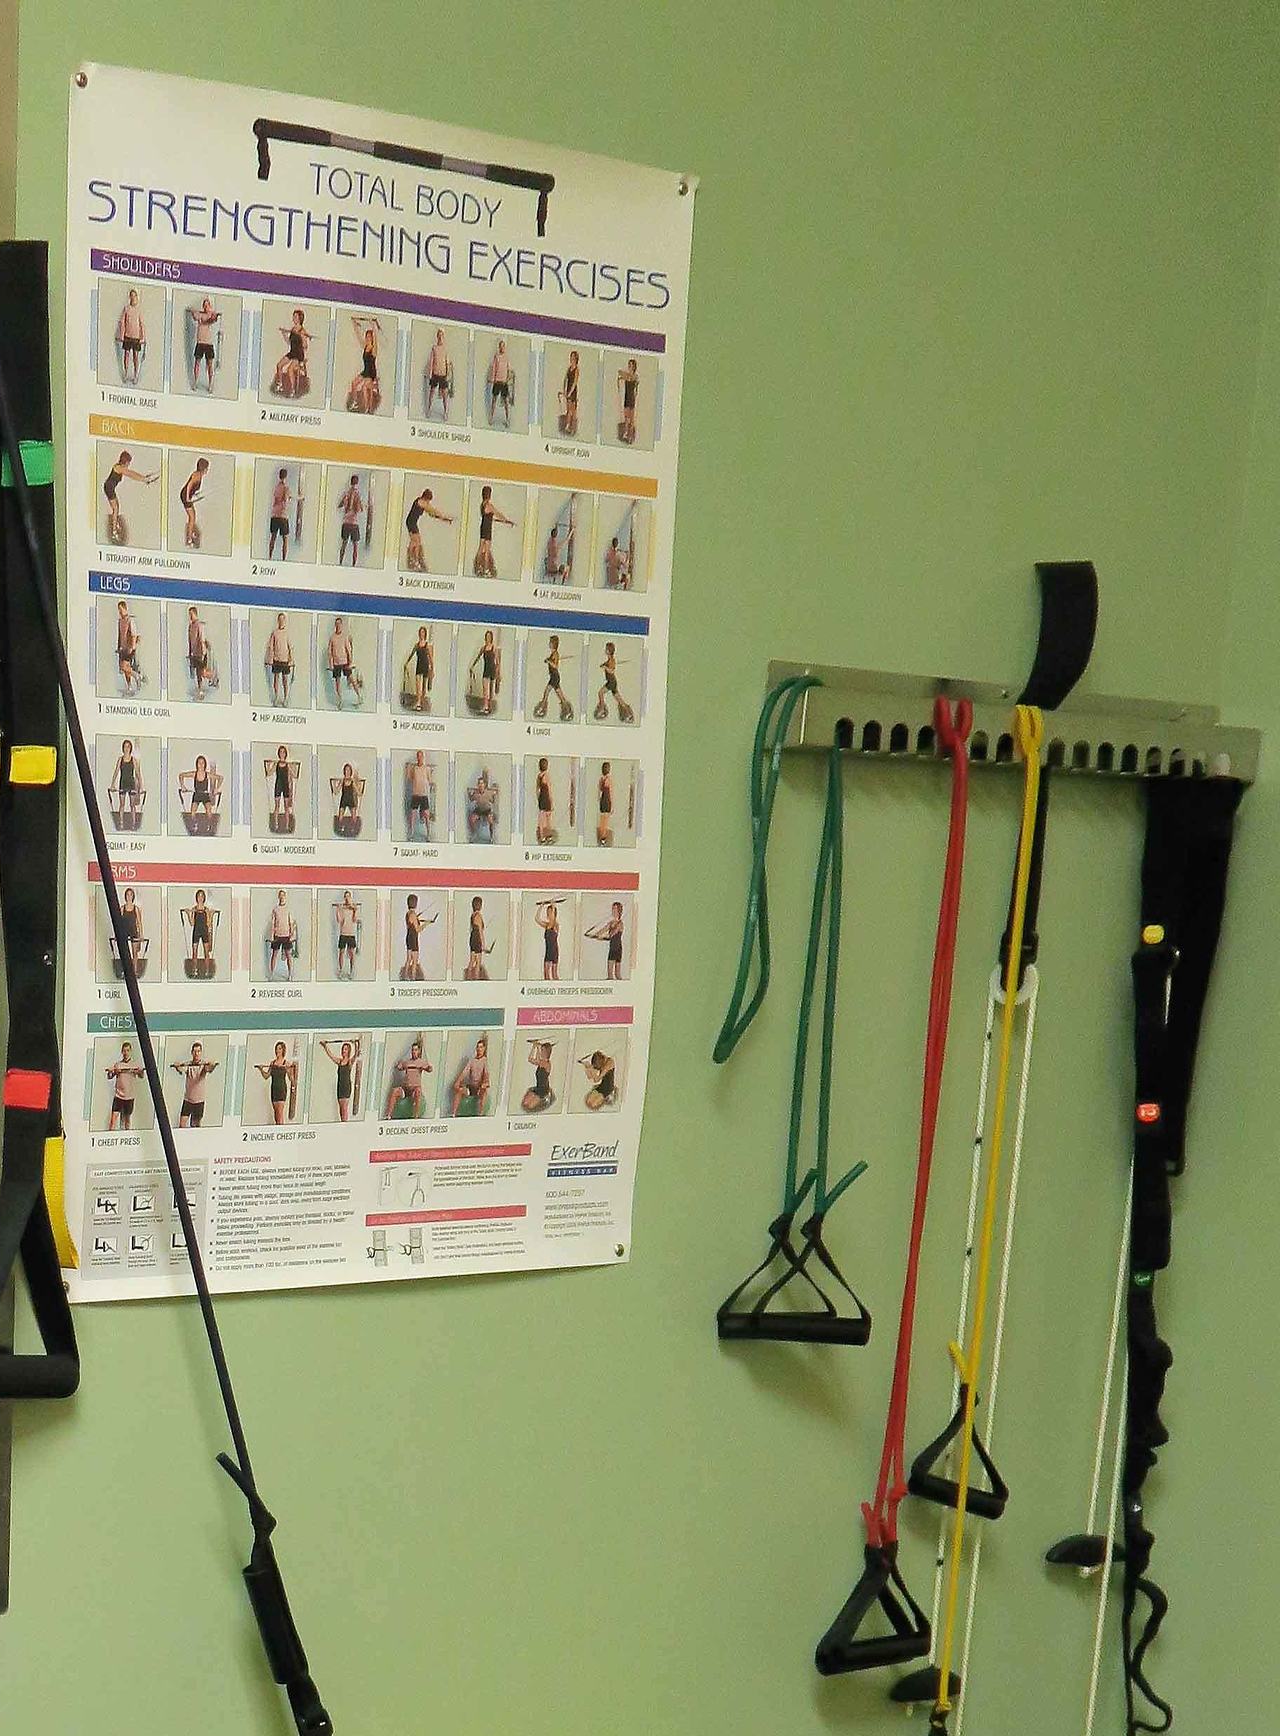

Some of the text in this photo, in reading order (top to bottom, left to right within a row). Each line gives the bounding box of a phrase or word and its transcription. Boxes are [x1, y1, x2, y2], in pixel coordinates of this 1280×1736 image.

[310, 162, 503, 229] TOTAL BODY
[87, 180, 672, 311] STRENGTHENING EXERCISES
[102, 253, 180, 279] SHOULDERS
[101, 391, 157, 408] 1 FRONTAL RAISE
[261, 410, 321, 426] 2 MILITARY PRESS
[411, 427, 415, 436] 3
[417, 428, 449, 440] SHOULDER
[544, 444, 548, 453] 4
[99, 552, 190, 569] 1 STRAIGHT ARM PULLDOWN
[252, 565, 276, 575] 2 ROW
[100, 575, 130, 591] LEGS
[398, 577, 454, 591] 3 BACK EXTENSION
[533, 588, 537, 597] 4
[551, 590, 581, 601] PULLDOWN
[98, 703, 170, 716] 1 STANDING LEG CURL
[252, 712, 306, 724] 2 HIP ABDUCTION
[392, 719, 397, 728] 3
[399, 721, 410, 729] HIP
[526, 726, 531, 734] 4
[130, 842, 146, 850] EASY
[252, 844, 257, 852] 6
[283, 845, 315, 854] MODERATE
[393, 847, 398, 856] 7
[422, 849, 438, 857] HARD
[524, 851, 529, 859] 8
[542, 853, 571, 861] EXTENSION
[111, 865, 136, 878] RMS
[97, 989, 120, 999] 1 CURL
[251, 988, 302, 998] 2 REVERSE CURL
[390, 987, 394, 996] 3
[397, 989, 420, 997] TRICEPS
[520, 987, 524, 995] 4
[100, 1015, 134, 1028] CHES
[378, 1125, 447, 1136] 3 DECLINE CHEST PRESS
[507, 1122, 510, 1130] 1
[242, 1131, 315, 1141] 2 INCLINE CHEST PRESS
[91, 1137, 140, 1146] 1 CHEST PRESS
[550, 1139, 619, 1161] ExerBand
[234, 1155, 271, 1163] PRECAUTIONS
